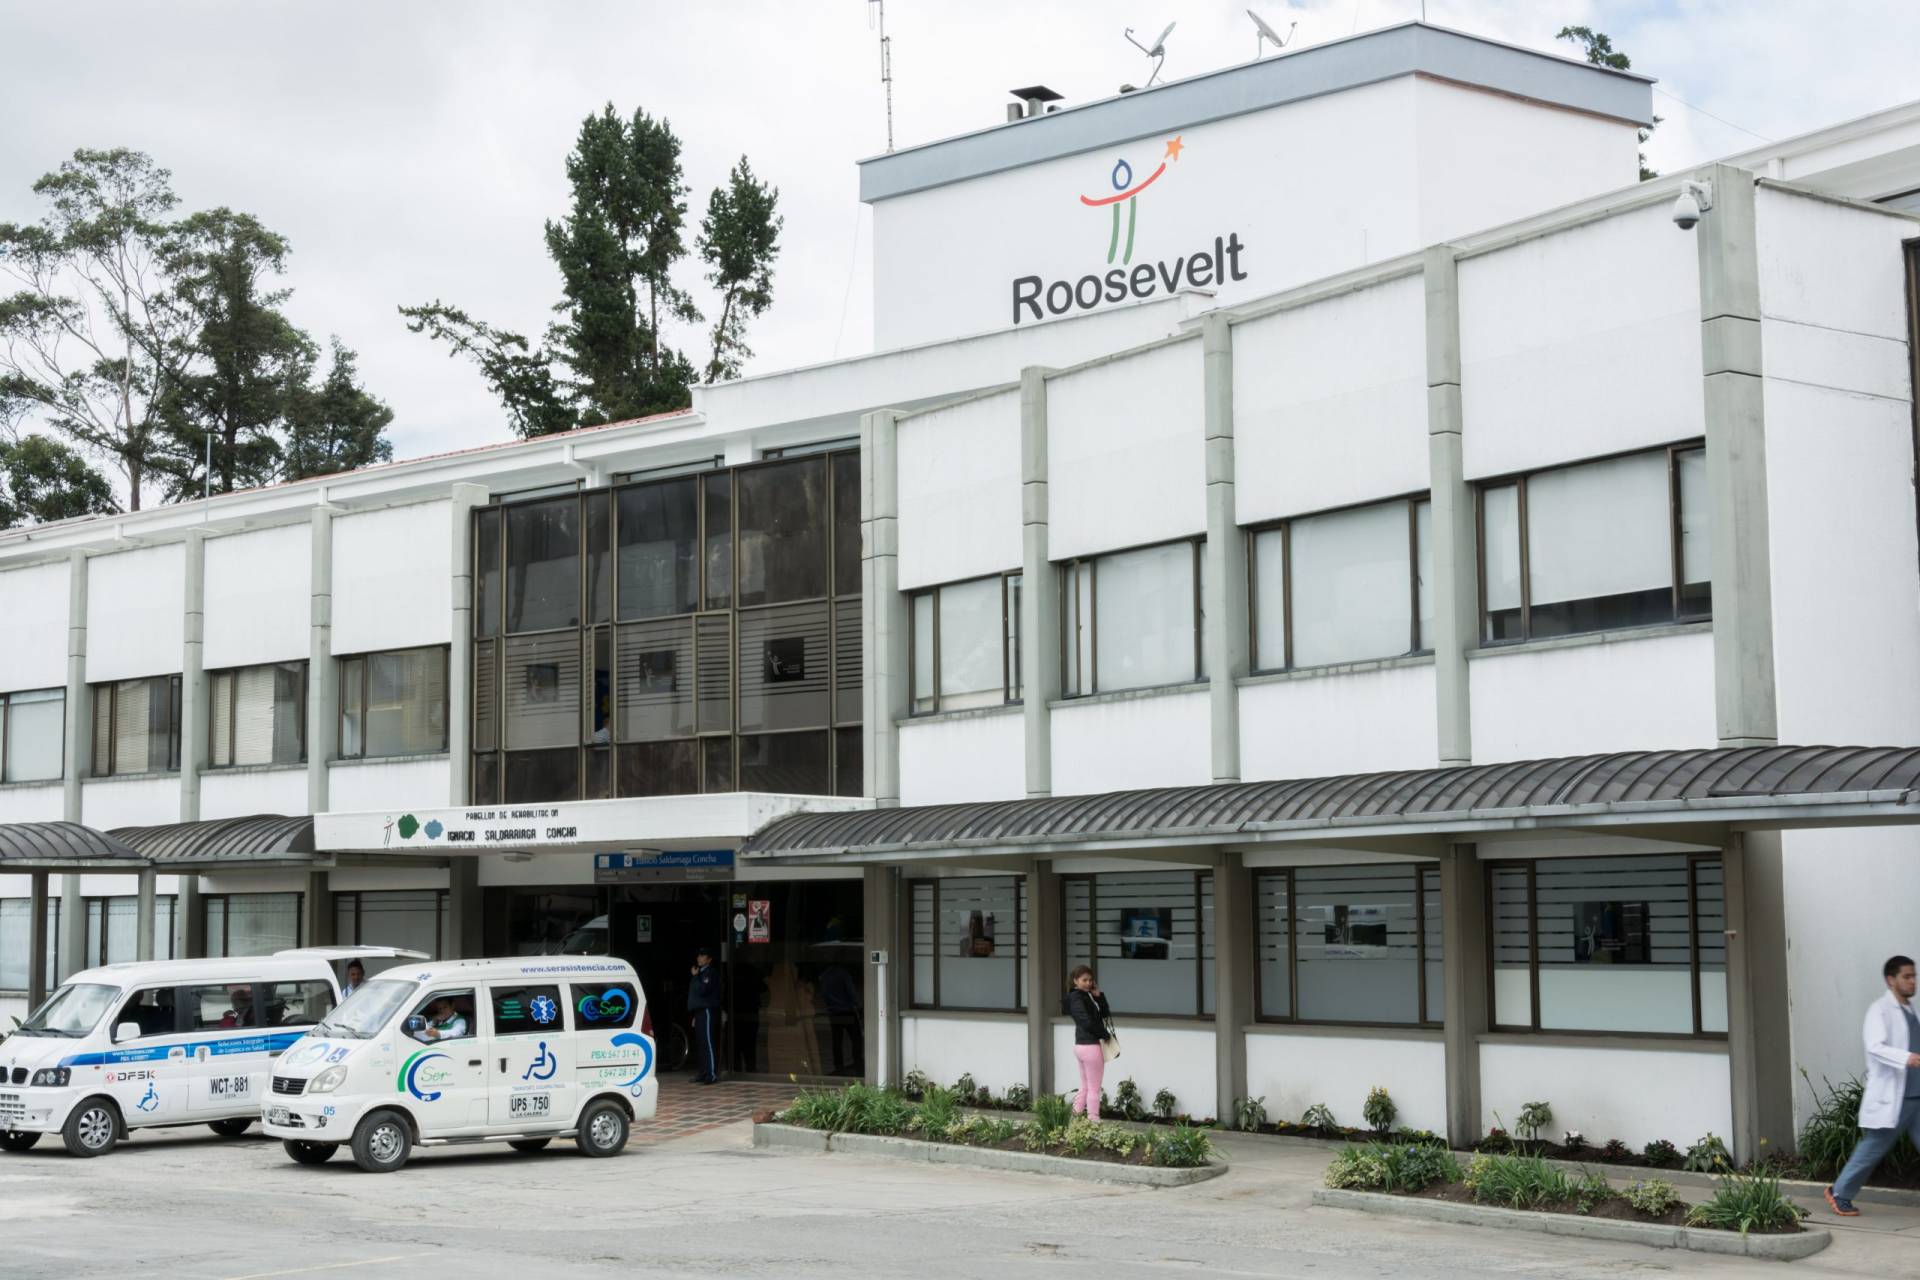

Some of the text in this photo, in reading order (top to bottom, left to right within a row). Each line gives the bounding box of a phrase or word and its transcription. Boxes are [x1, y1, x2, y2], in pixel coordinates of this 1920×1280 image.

[1013, 233, 1248, 324] Roosevelt
[466, 811, 495, 820] PABELLON
[499, 811, 507, 819] DE
[448, 831, 475, 841] IGNACIO
[546, 827, 577, 839] CONCHA
[520, 964, 626, 973] www.serasistencia.com
[600, 1001, 624, 1015] Ser
[118, 1071, 155, 1081] DFSK
[421, 1066, 451, 1081] Ser
[323, 1105, 335, 1115] 05
